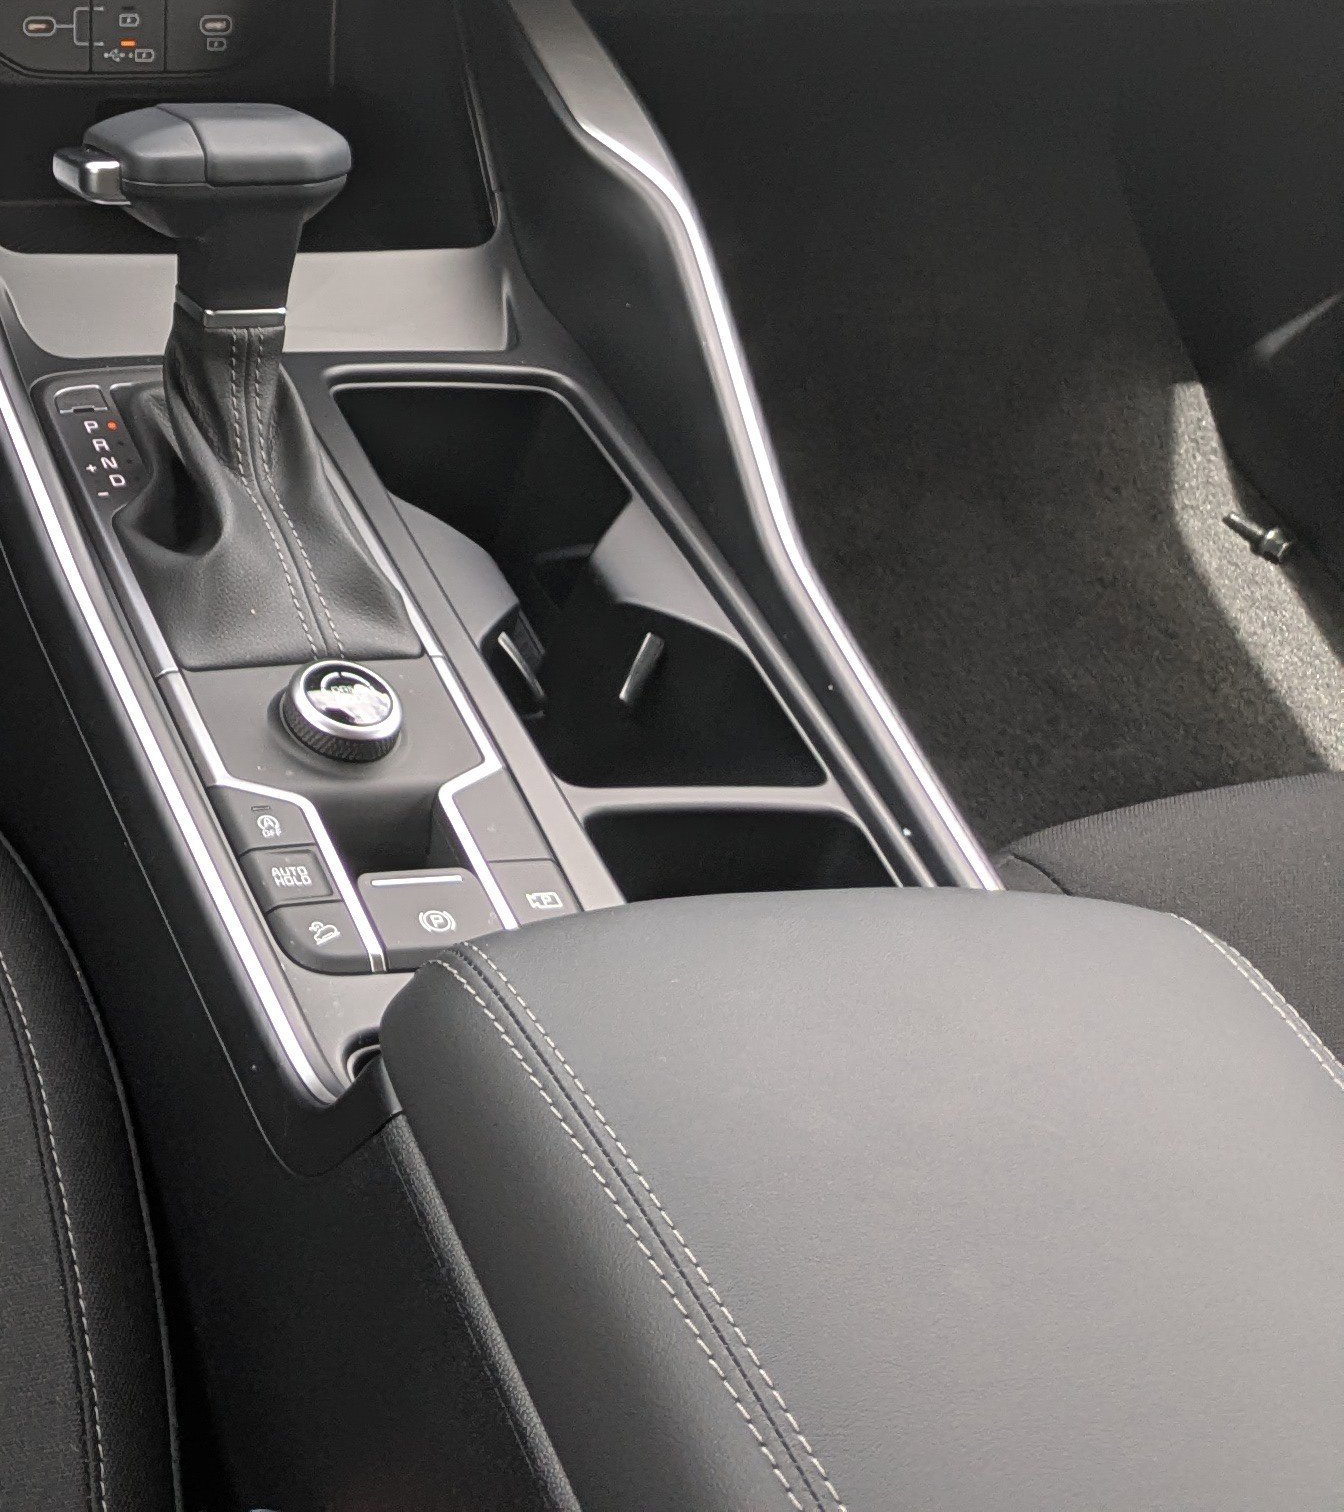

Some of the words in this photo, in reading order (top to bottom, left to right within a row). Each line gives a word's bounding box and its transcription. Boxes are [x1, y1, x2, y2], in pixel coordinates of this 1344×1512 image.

[83, 420, 99, 434] P
[92, 438, 111, 453] R
[100, 456, 119, 470] N
[108, 473, 127, 488] D
[271, 866, 308, 877] AUTO
[274, 875, 311, 887] HOLD
